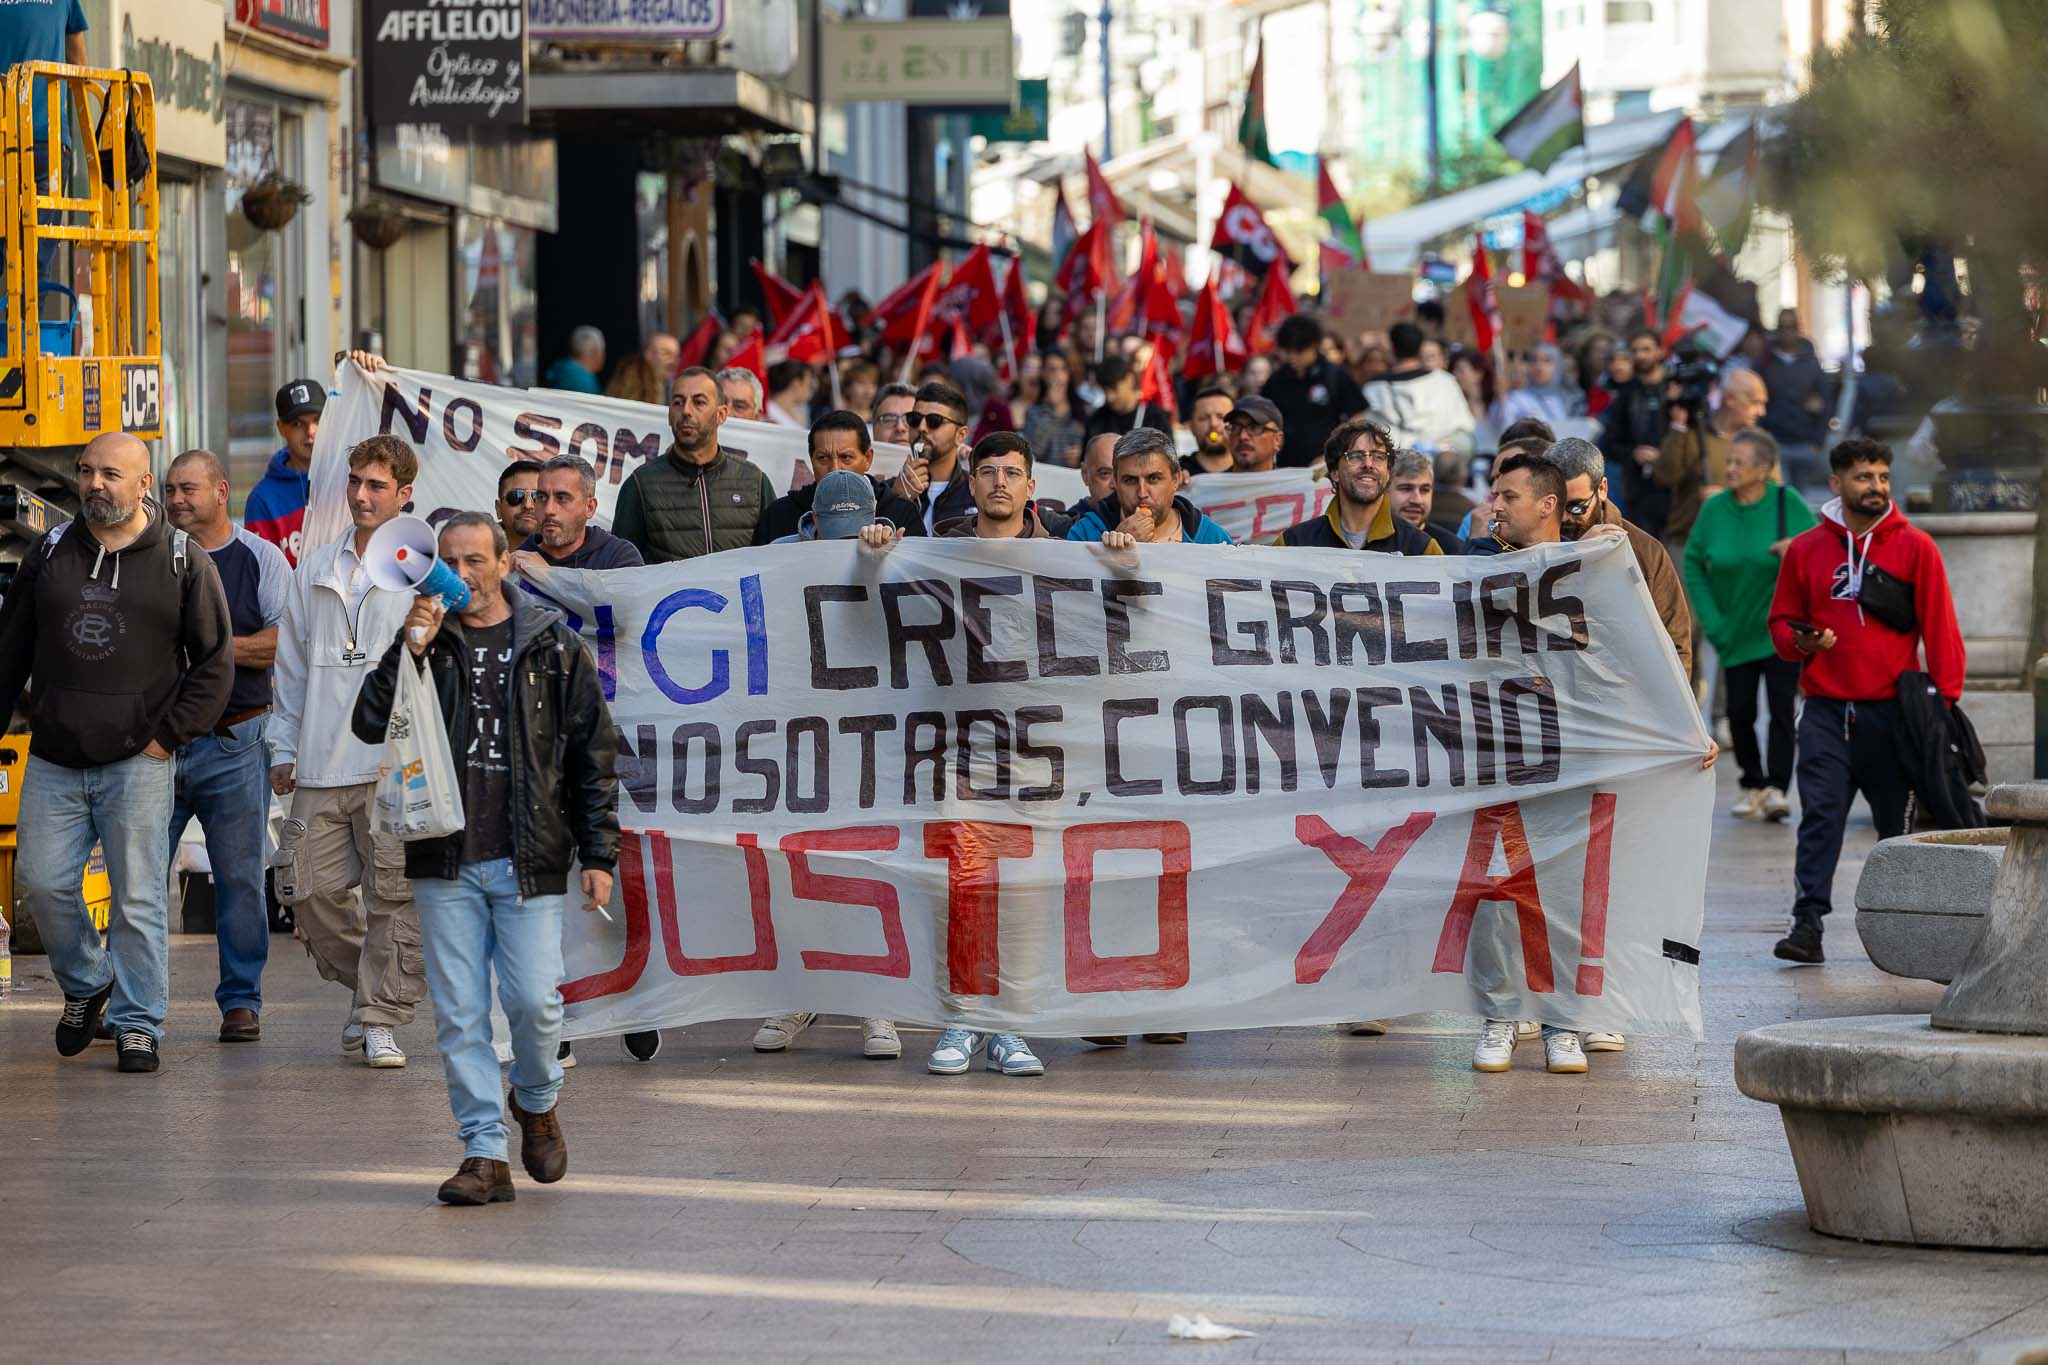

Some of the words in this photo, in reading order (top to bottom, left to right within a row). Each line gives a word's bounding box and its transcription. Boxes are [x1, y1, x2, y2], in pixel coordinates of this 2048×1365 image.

[376, 9, 522, 42] AFFLELOU
[378, 381, 483, 452] NO
[520, 573, 769, 704] IGI
[803, 574, 1171, 690] CRECE
[1206, 559, 1590, 667] GRACIAS
[1102, 676, 1562, 798] CONVENIO
[555, 820, 1193, 1005] JUSTO
[1294, 792, 1618, 997] YA!
